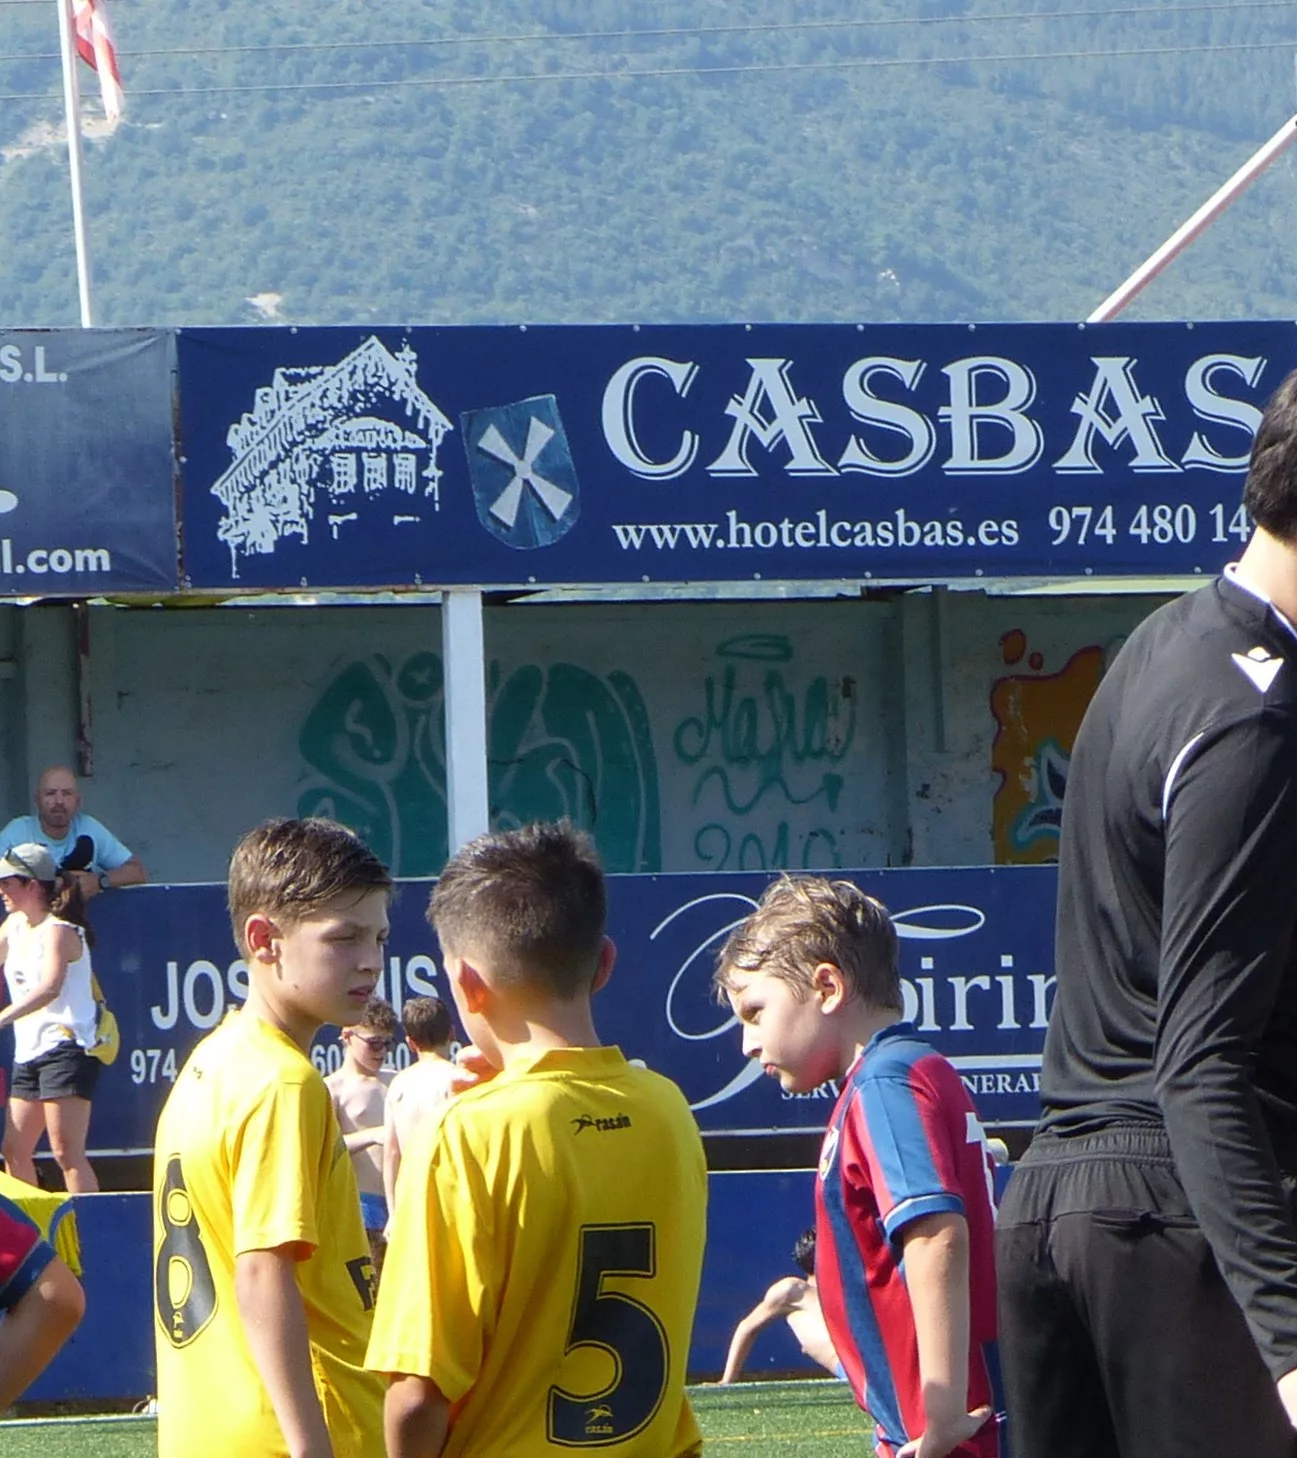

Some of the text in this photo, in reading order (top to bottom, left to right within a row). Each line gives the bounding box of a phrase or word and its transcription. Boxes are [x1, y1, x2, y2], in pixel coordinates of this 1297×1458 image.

[602, 353, 1267, 480] CASBAS
[612, 508, 1019, 550] www.hotelcasbas.es
[1049, 506, 1117, 546] 974
[1129, 505, 1196, 544] 480
[131, 1049, 178, 1084] 974
[311, 1044, 345, 1077] 60
[156, 1153, 219, 1349] 8
[546, 1221, 671, 1448] 5
